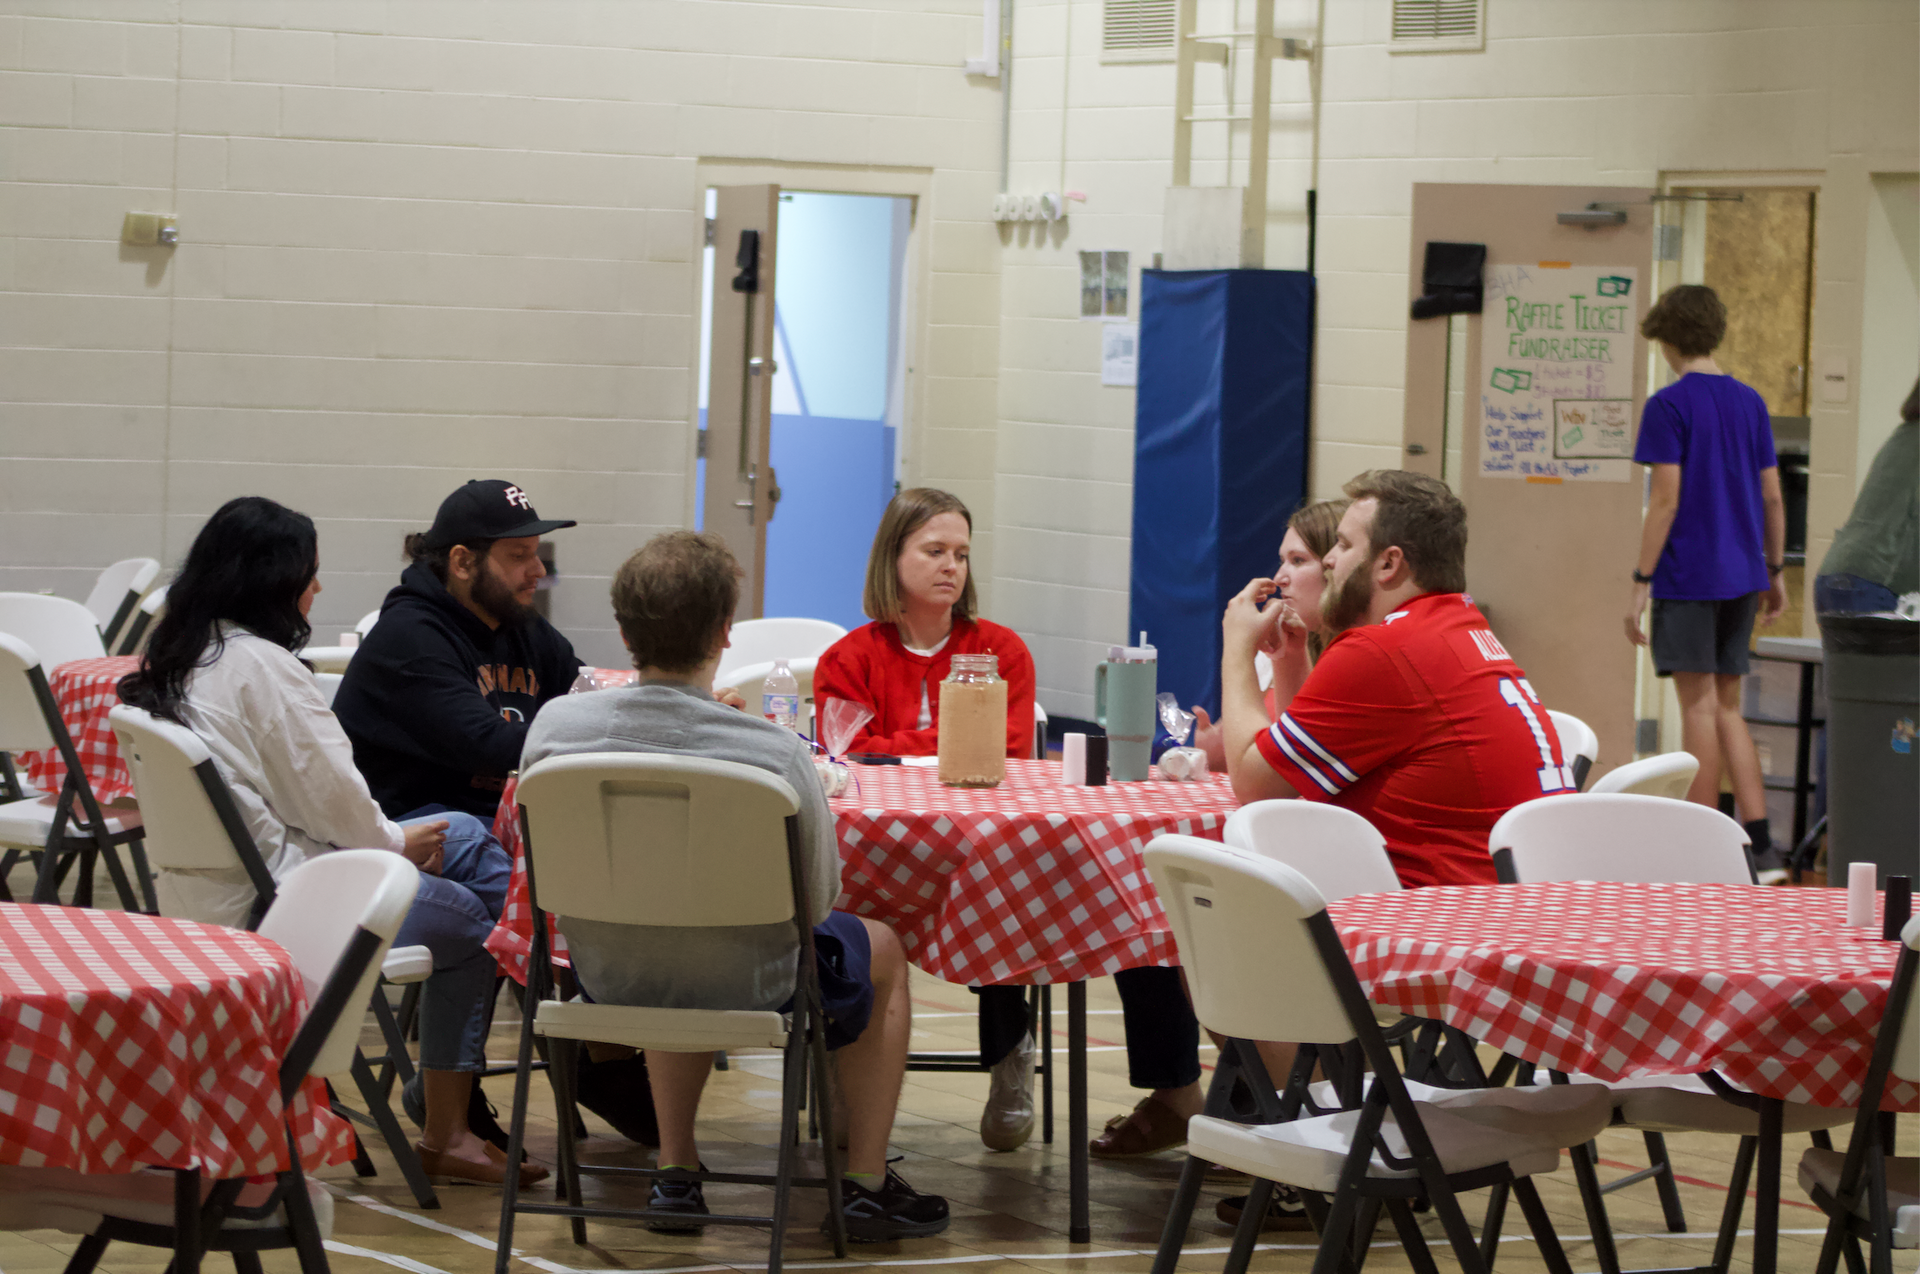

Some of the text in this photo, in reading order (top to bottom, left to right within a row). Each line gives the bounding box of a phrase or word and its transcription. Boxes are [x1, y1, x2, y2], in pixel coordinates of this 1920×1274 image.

[1506, 295, 1628, 332] RAFFLE TICKET
[1509, 332, 1612, 361] FUNDRAISER
